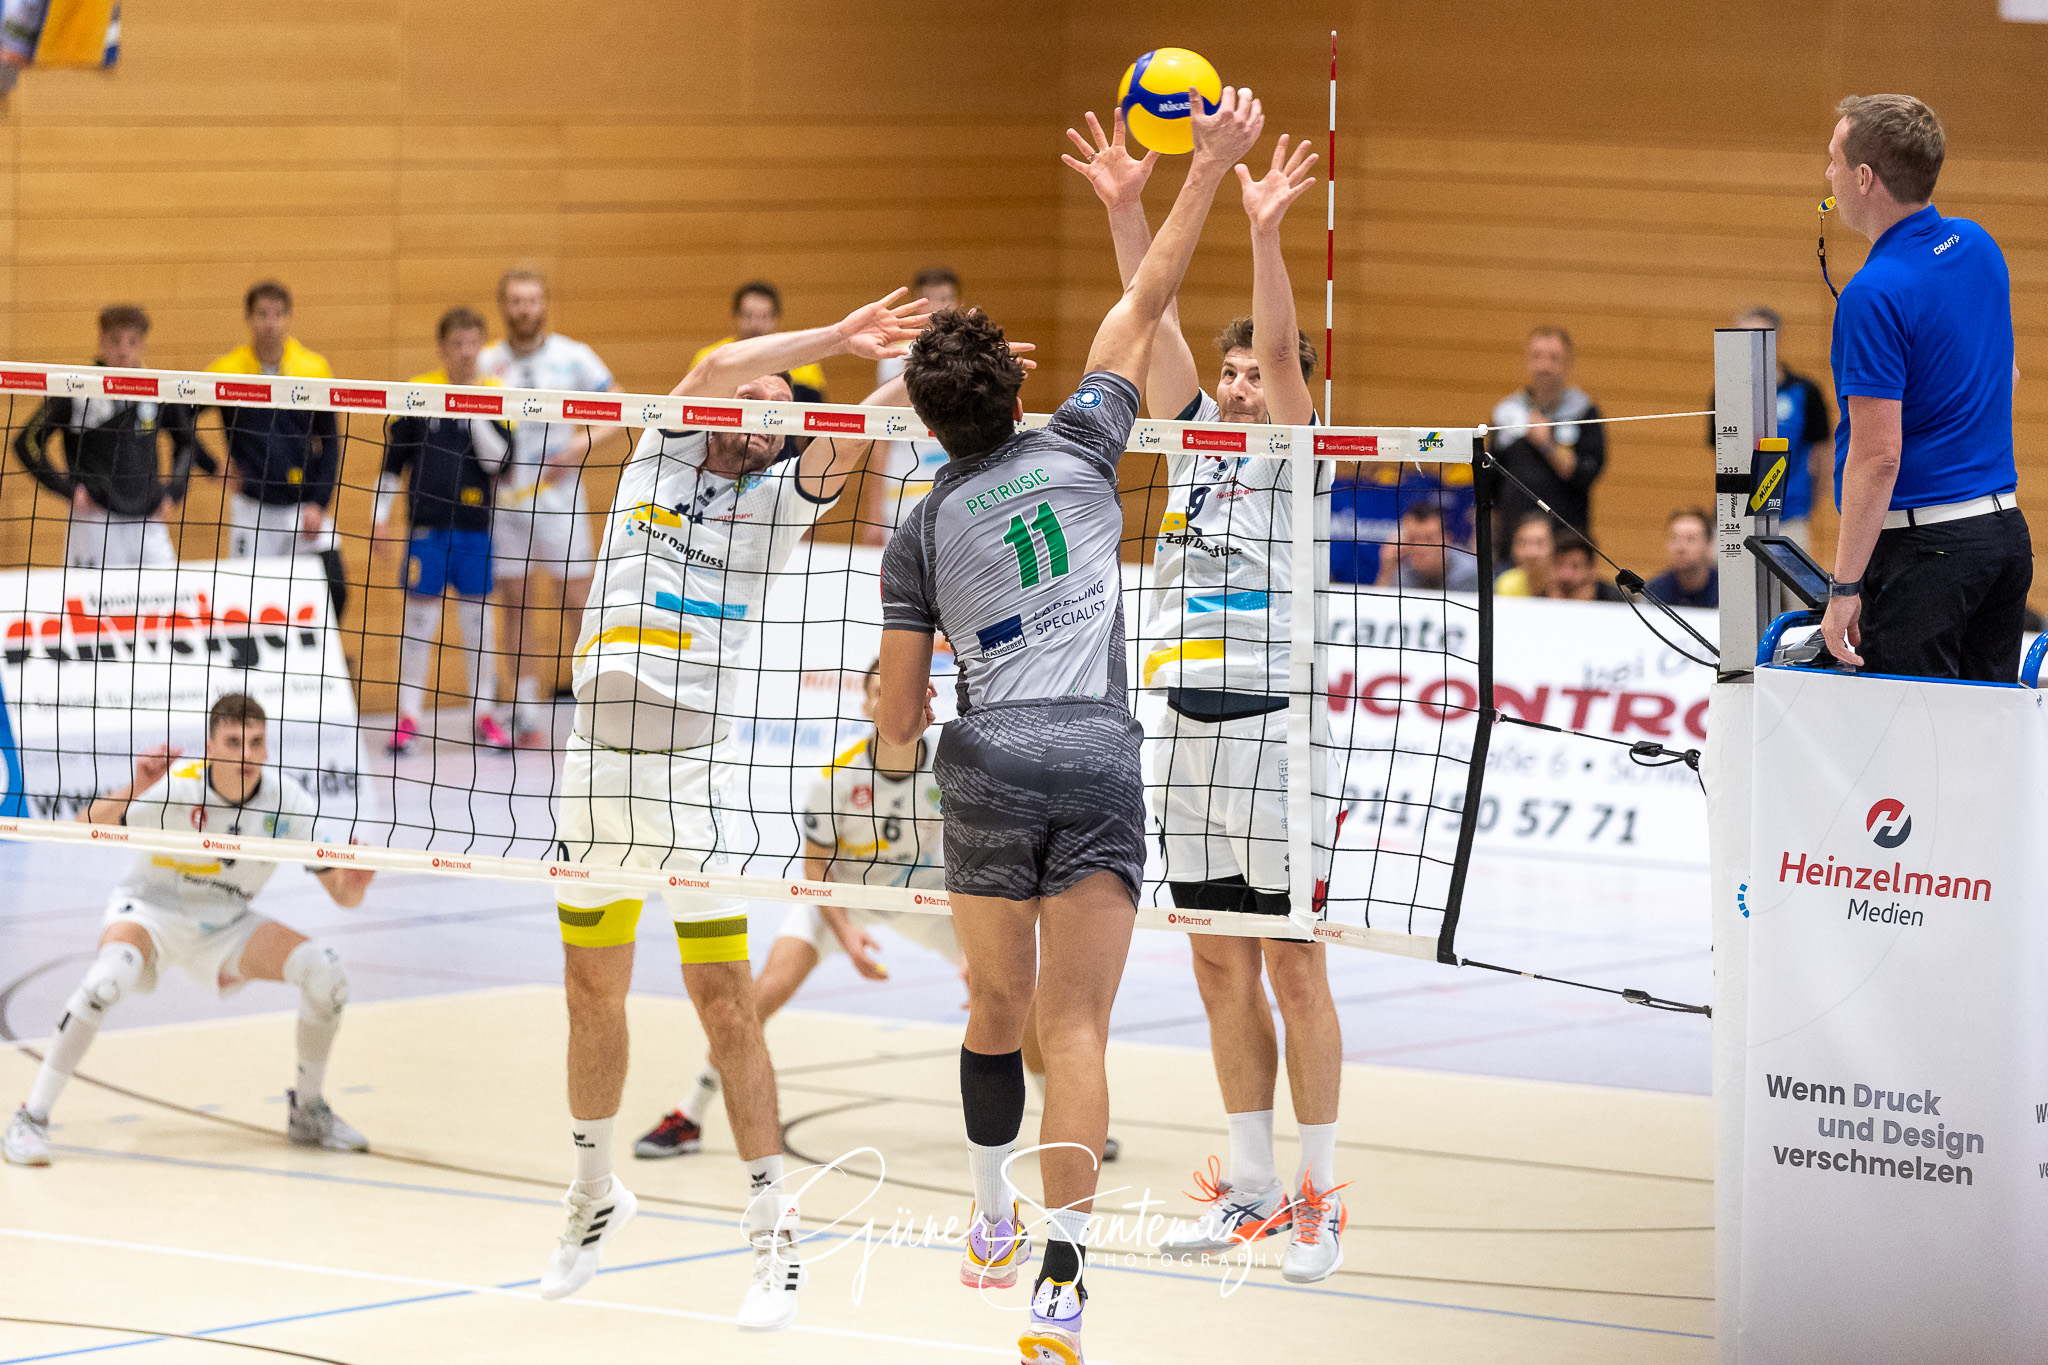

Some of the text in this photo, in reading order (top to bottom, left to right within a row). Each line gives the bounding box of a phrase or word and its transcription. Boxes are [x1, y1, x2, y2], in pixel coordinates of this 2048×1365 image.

[1159, 100, 1191, 112] MIKAS
[1933, 235, 1956, 255] CRAFT
[1195, 438, 1218, 446] Sparkasse
[1418, 438, 1443, 449] HUCK
[965, 468, 1050, 517] PETRUSIC
[1001, 500, 1070, 591] 11
[1035, 599, 1105, 636] SPECIALIST
[100, 831, 128, 841] Marmot
[211, 841, 241, 850] Marmot
[325, 850, 355, 860] Marmot
[441, 859, 471, 869] Marmot
[558, 868, 589, 878] Marmot
[1779, 852, 1991, 901] Heinzelmann
[678, 878, 710, 888] Marmot
[800, 887, 832, 897] Marmot
[1847, 898, 1924, 926] Medien
[1178, 915, 1212, 926] Marmot
[1313, 927, 1342, 939] armot
[1766, 1073, 1941, 1116] Wenn Druck
[1818, 1116, 1984, 1160] und Design
[1773, 1145, 1973, 1186] verschmelzen
